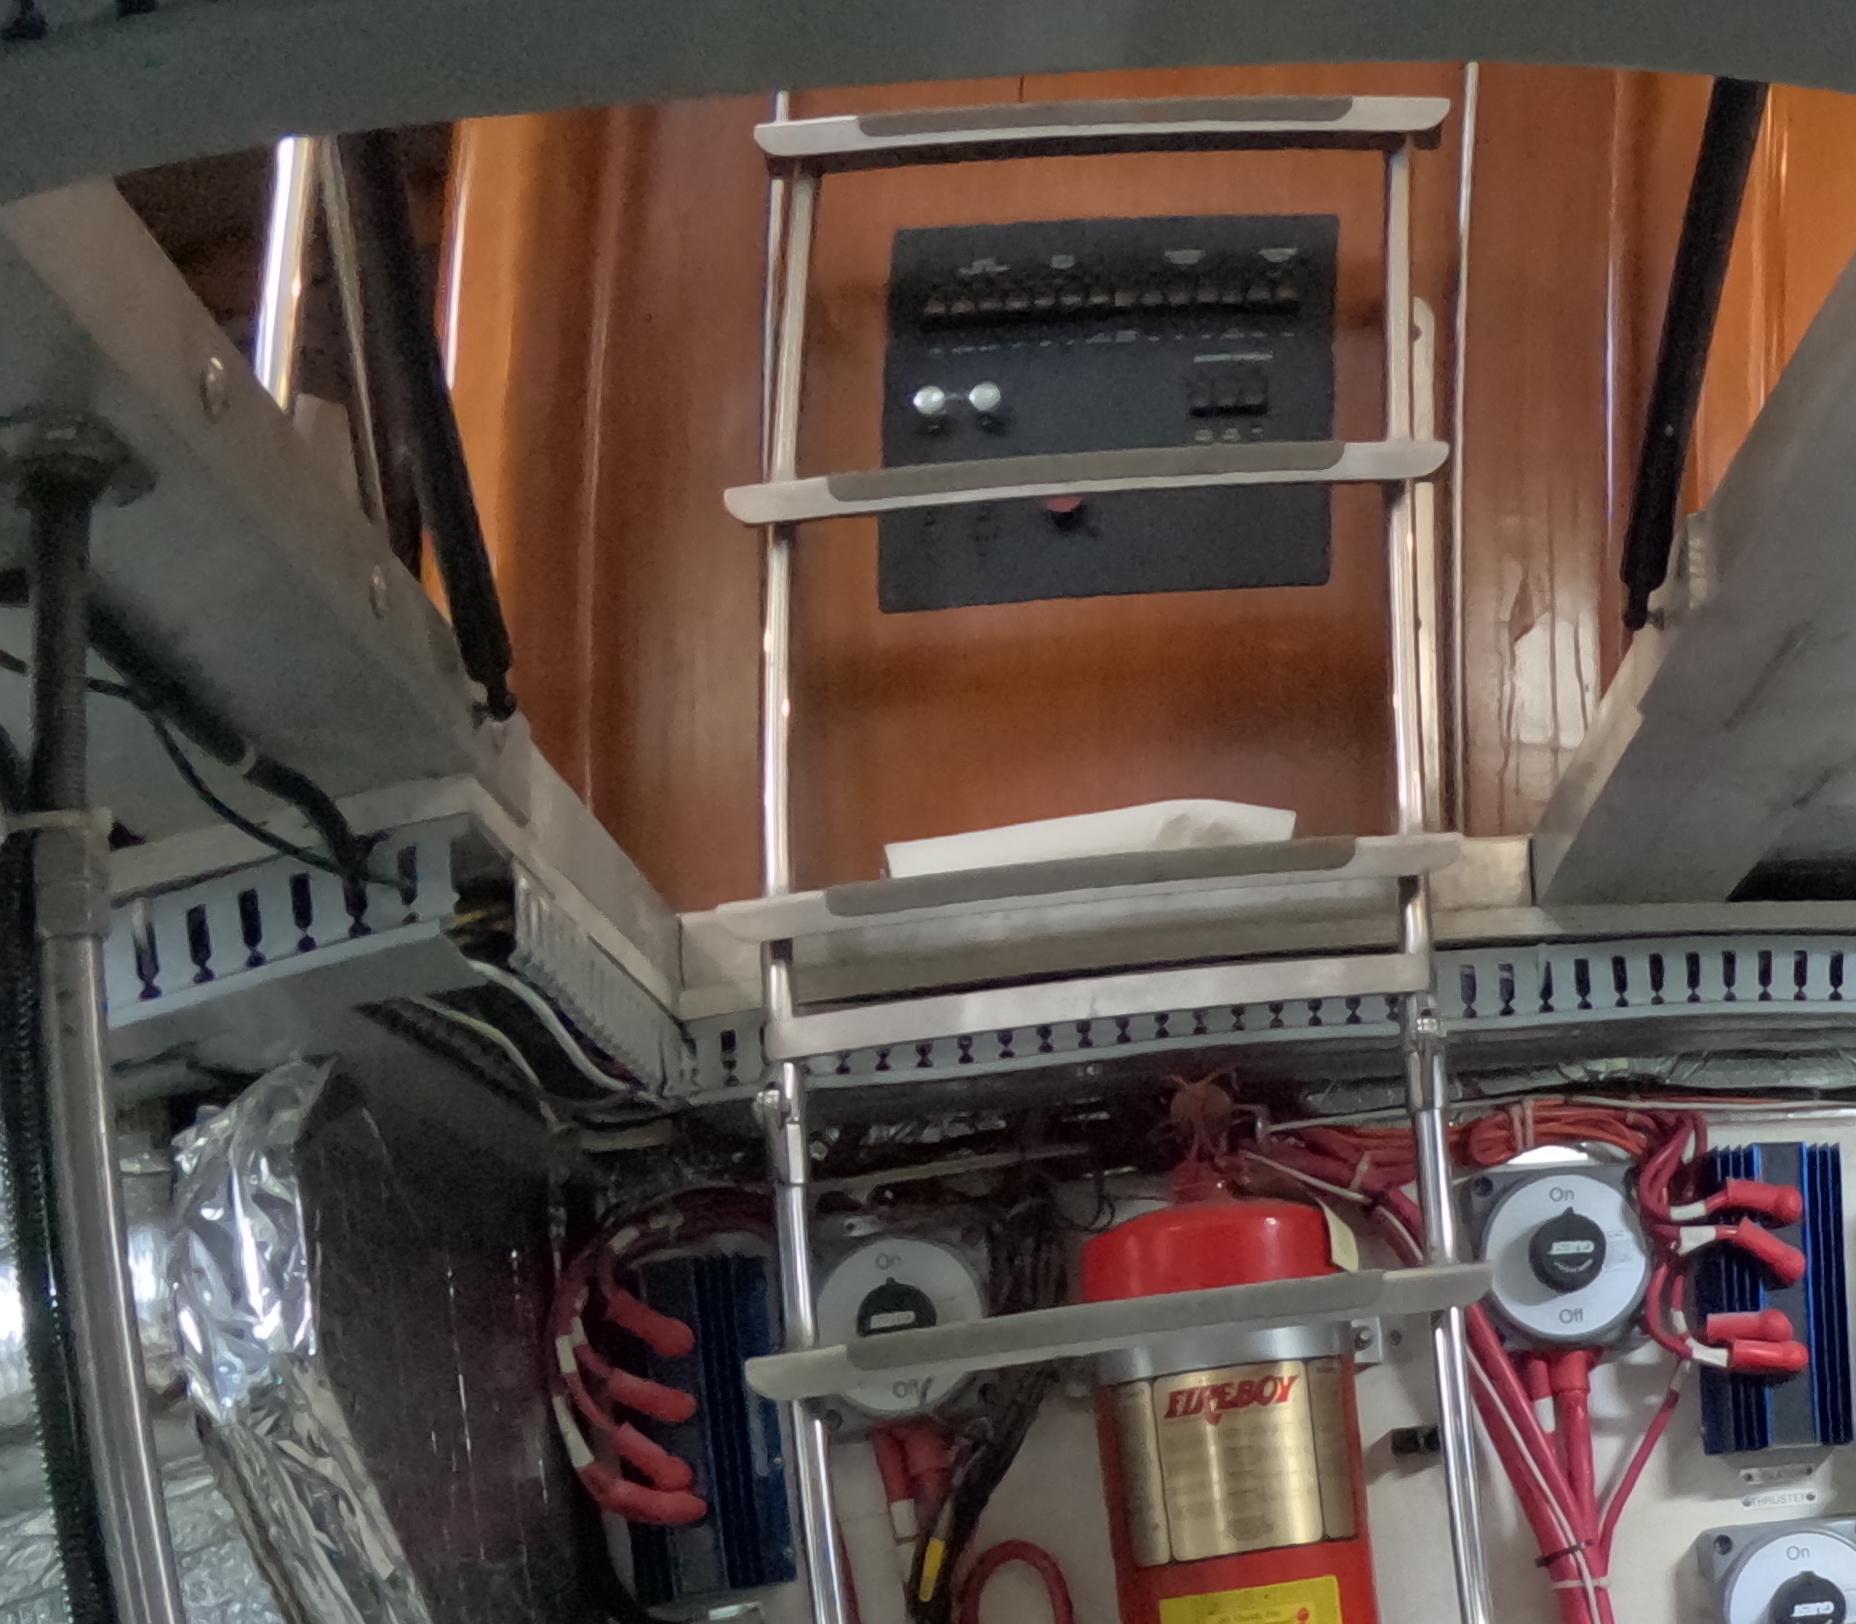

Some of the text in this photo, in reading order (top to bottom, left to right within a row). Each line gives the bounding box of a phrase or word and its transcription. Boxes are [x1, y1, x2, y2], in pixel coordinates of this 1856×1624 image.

[1549, 1186, 1575, 1202] On
[875, 1252, 902, 1270] On
[1558, 1308, 1584, 1324] Off
[1786, 1545, 1810, 1561] On
